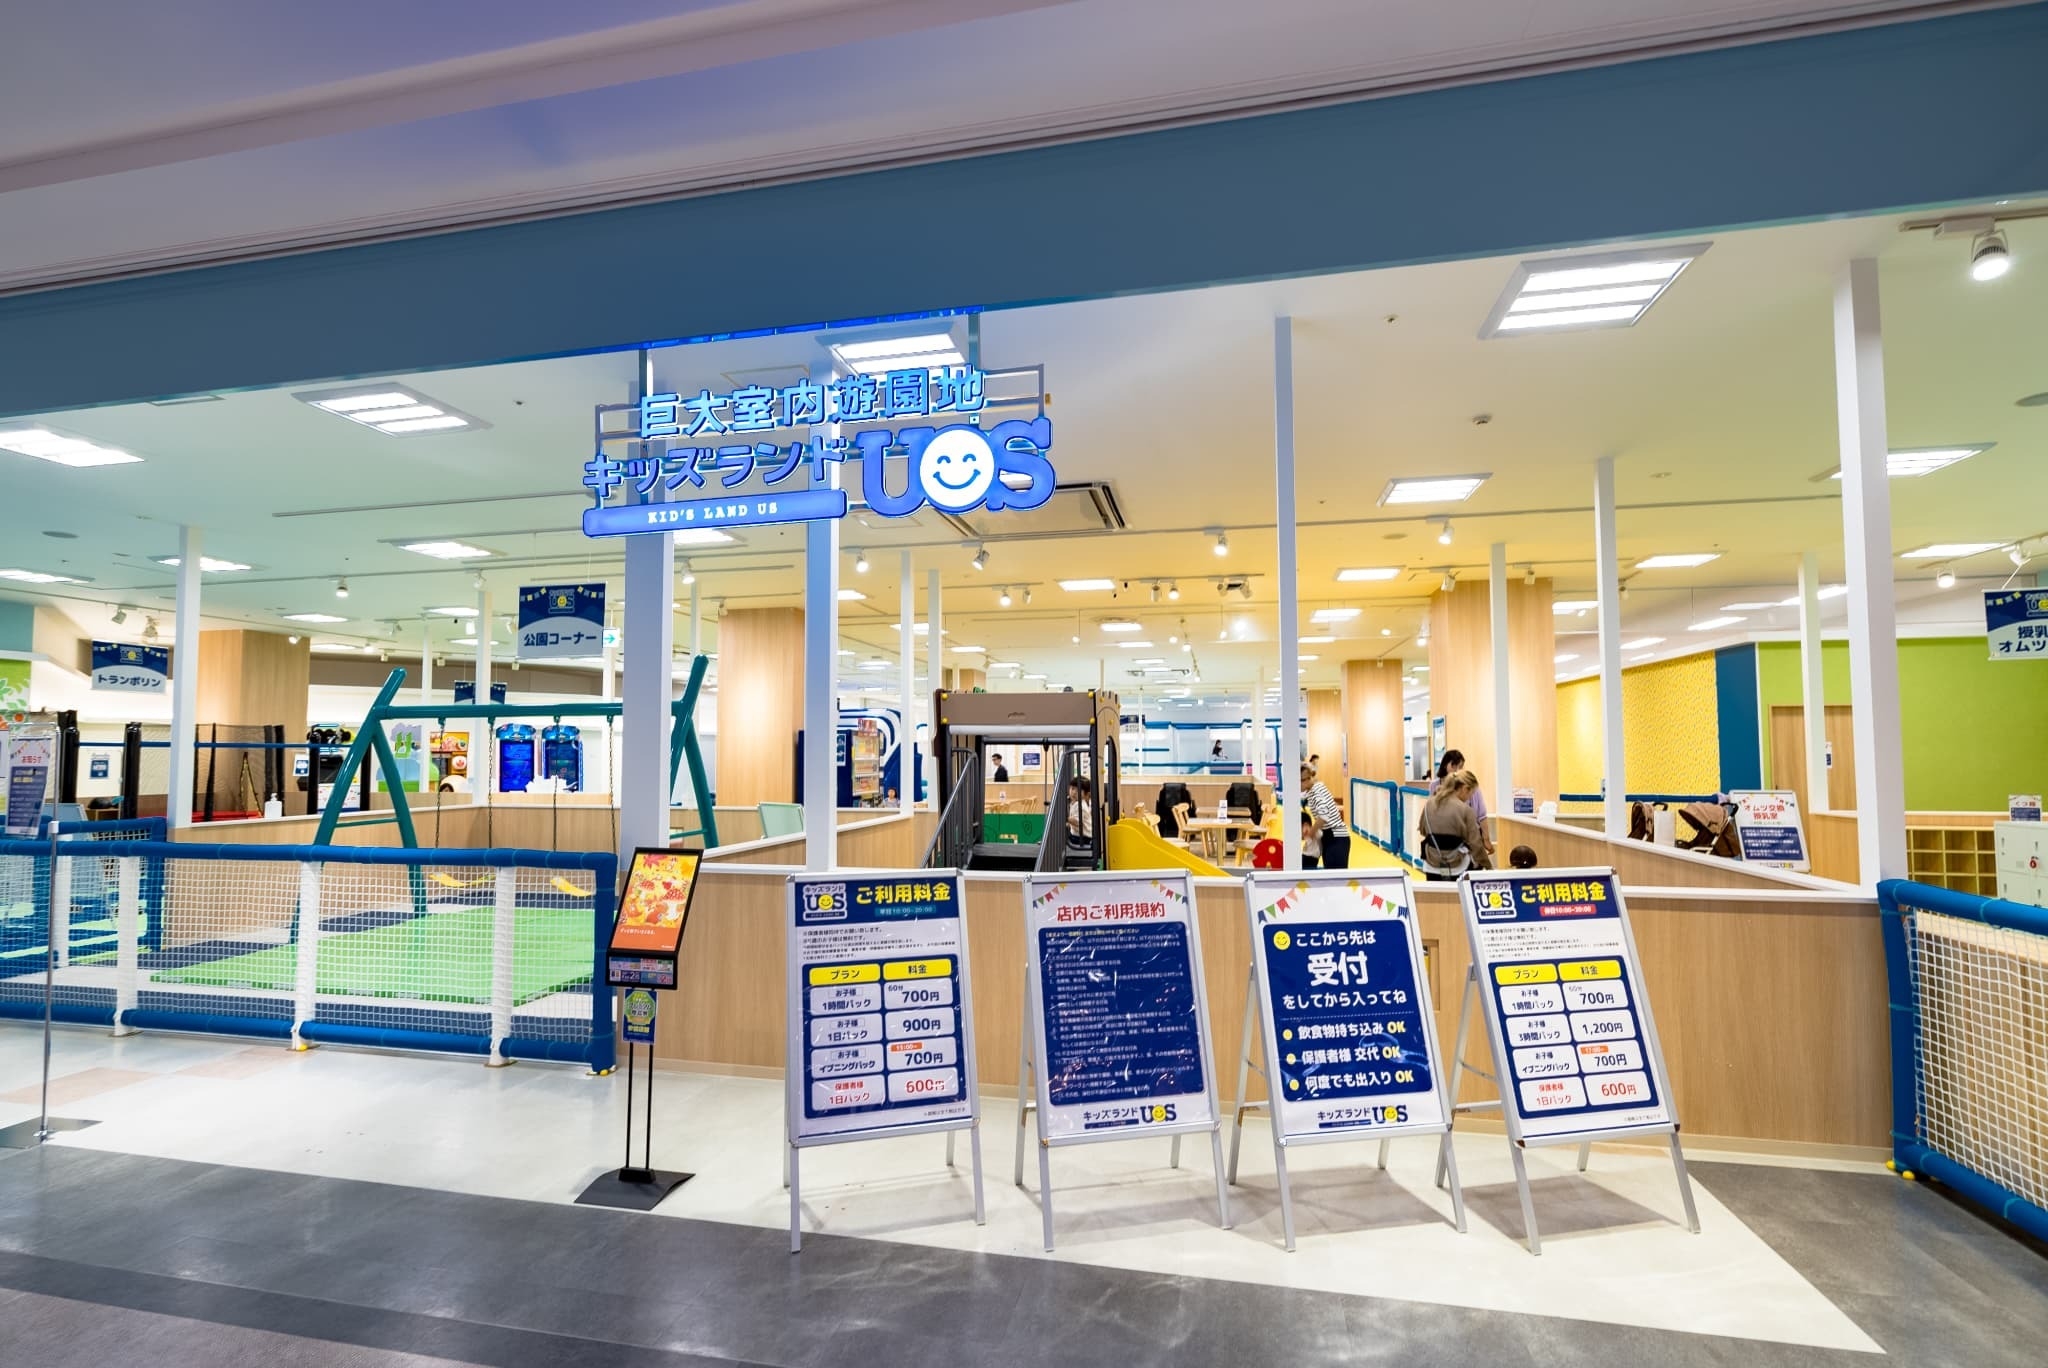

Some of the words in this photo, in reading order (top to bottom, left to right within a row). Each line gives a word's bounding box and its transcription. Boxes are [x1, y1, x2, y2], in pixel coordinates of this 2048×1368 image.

[638, 365, 987, 439] 巨大室内遊園地
[583, 434, 847, 497] キッズランド
[647, 507, 695, 524] KID'S
[704, 505, 748, 520] LAND
[757, 502, 778, 515] US
[2018, 625, 2048, 639] 授乳
[524, 632, 597, 647] 公園コーナー
[1998, 640, 2047, 653] オムツ
[98, 673, 161, 688] トランポリン
[856, 882, 951, 905] ご利用料金
[1521, 881, 1607, 903] ご利用料金
[1057, 902, 1166, 922] 店内ご利用規約
[1296, 930, 1376, 947] ここから先は
[831, 969, 860, 980] プラン
[908, 964, 928, 975] 料金
[1307, 951, 1369, 987] 受付
[1513, 969, 1539, 979] プラン
[1580, 966, 1599, 976] 料金
[835, 988, 857, 997] お子様
[902, 990, 940, 1003] 700円
[1521, 989, 1539, 997] お子様
[1579, 992, 1615, 1005] 700円
[822, 999, 871, 1011] 1時間パック
[1283, 989, 1407, 1010] をしてから入ってね
[1512, 1000, 1554, 1011] 1時間パック
[837, 1019, 858, 1028] お子様
[903, 1018, 941, 1032] 900円
[1298, 1024, 1384, 1040] 飲食物持ち込み
[1387, 1020, 1406, 1035] OK
[1528, 1021, 1546, 1029] お子様
[1582, 1022, 1623, 1035] 1,200円
[828, 1030, 868, 1041] 1日パック
[1519, 1031, 1561, 1042] 3時間パック
[837, 1050, 859, 1059] お子様
[905, 1052, 943, 1066] 700円
[1301, 1048, 1351, 1065] 保護者様
[1355, 1047, 1379, 1061] 交代
[1382, 1046, 1401, 1060] OK
[1535, 1052, 1554, 1060] お子様
[1594, 1053, 1628, 1067] 700円
[819, 1060, 875, 1073] イブニングパック
[1522, 1063, 1570, 1074] イブニングパック
[835, 1081, 864, 1091] 保護者様
[906, 1079, 945, 1093] 600円
[1305, 1073, 1392, 1092] 何度でも出入り
[1395, 1070, 1414, 1085] OK
[1601, 1082, 1637, 1096] 600円
[1536, 1095, 1572, 1106] 1日パック
[1083, 1107, 1138, 1120] キッズランド
[1317, 1107, 1371, 1120] キッズランド
